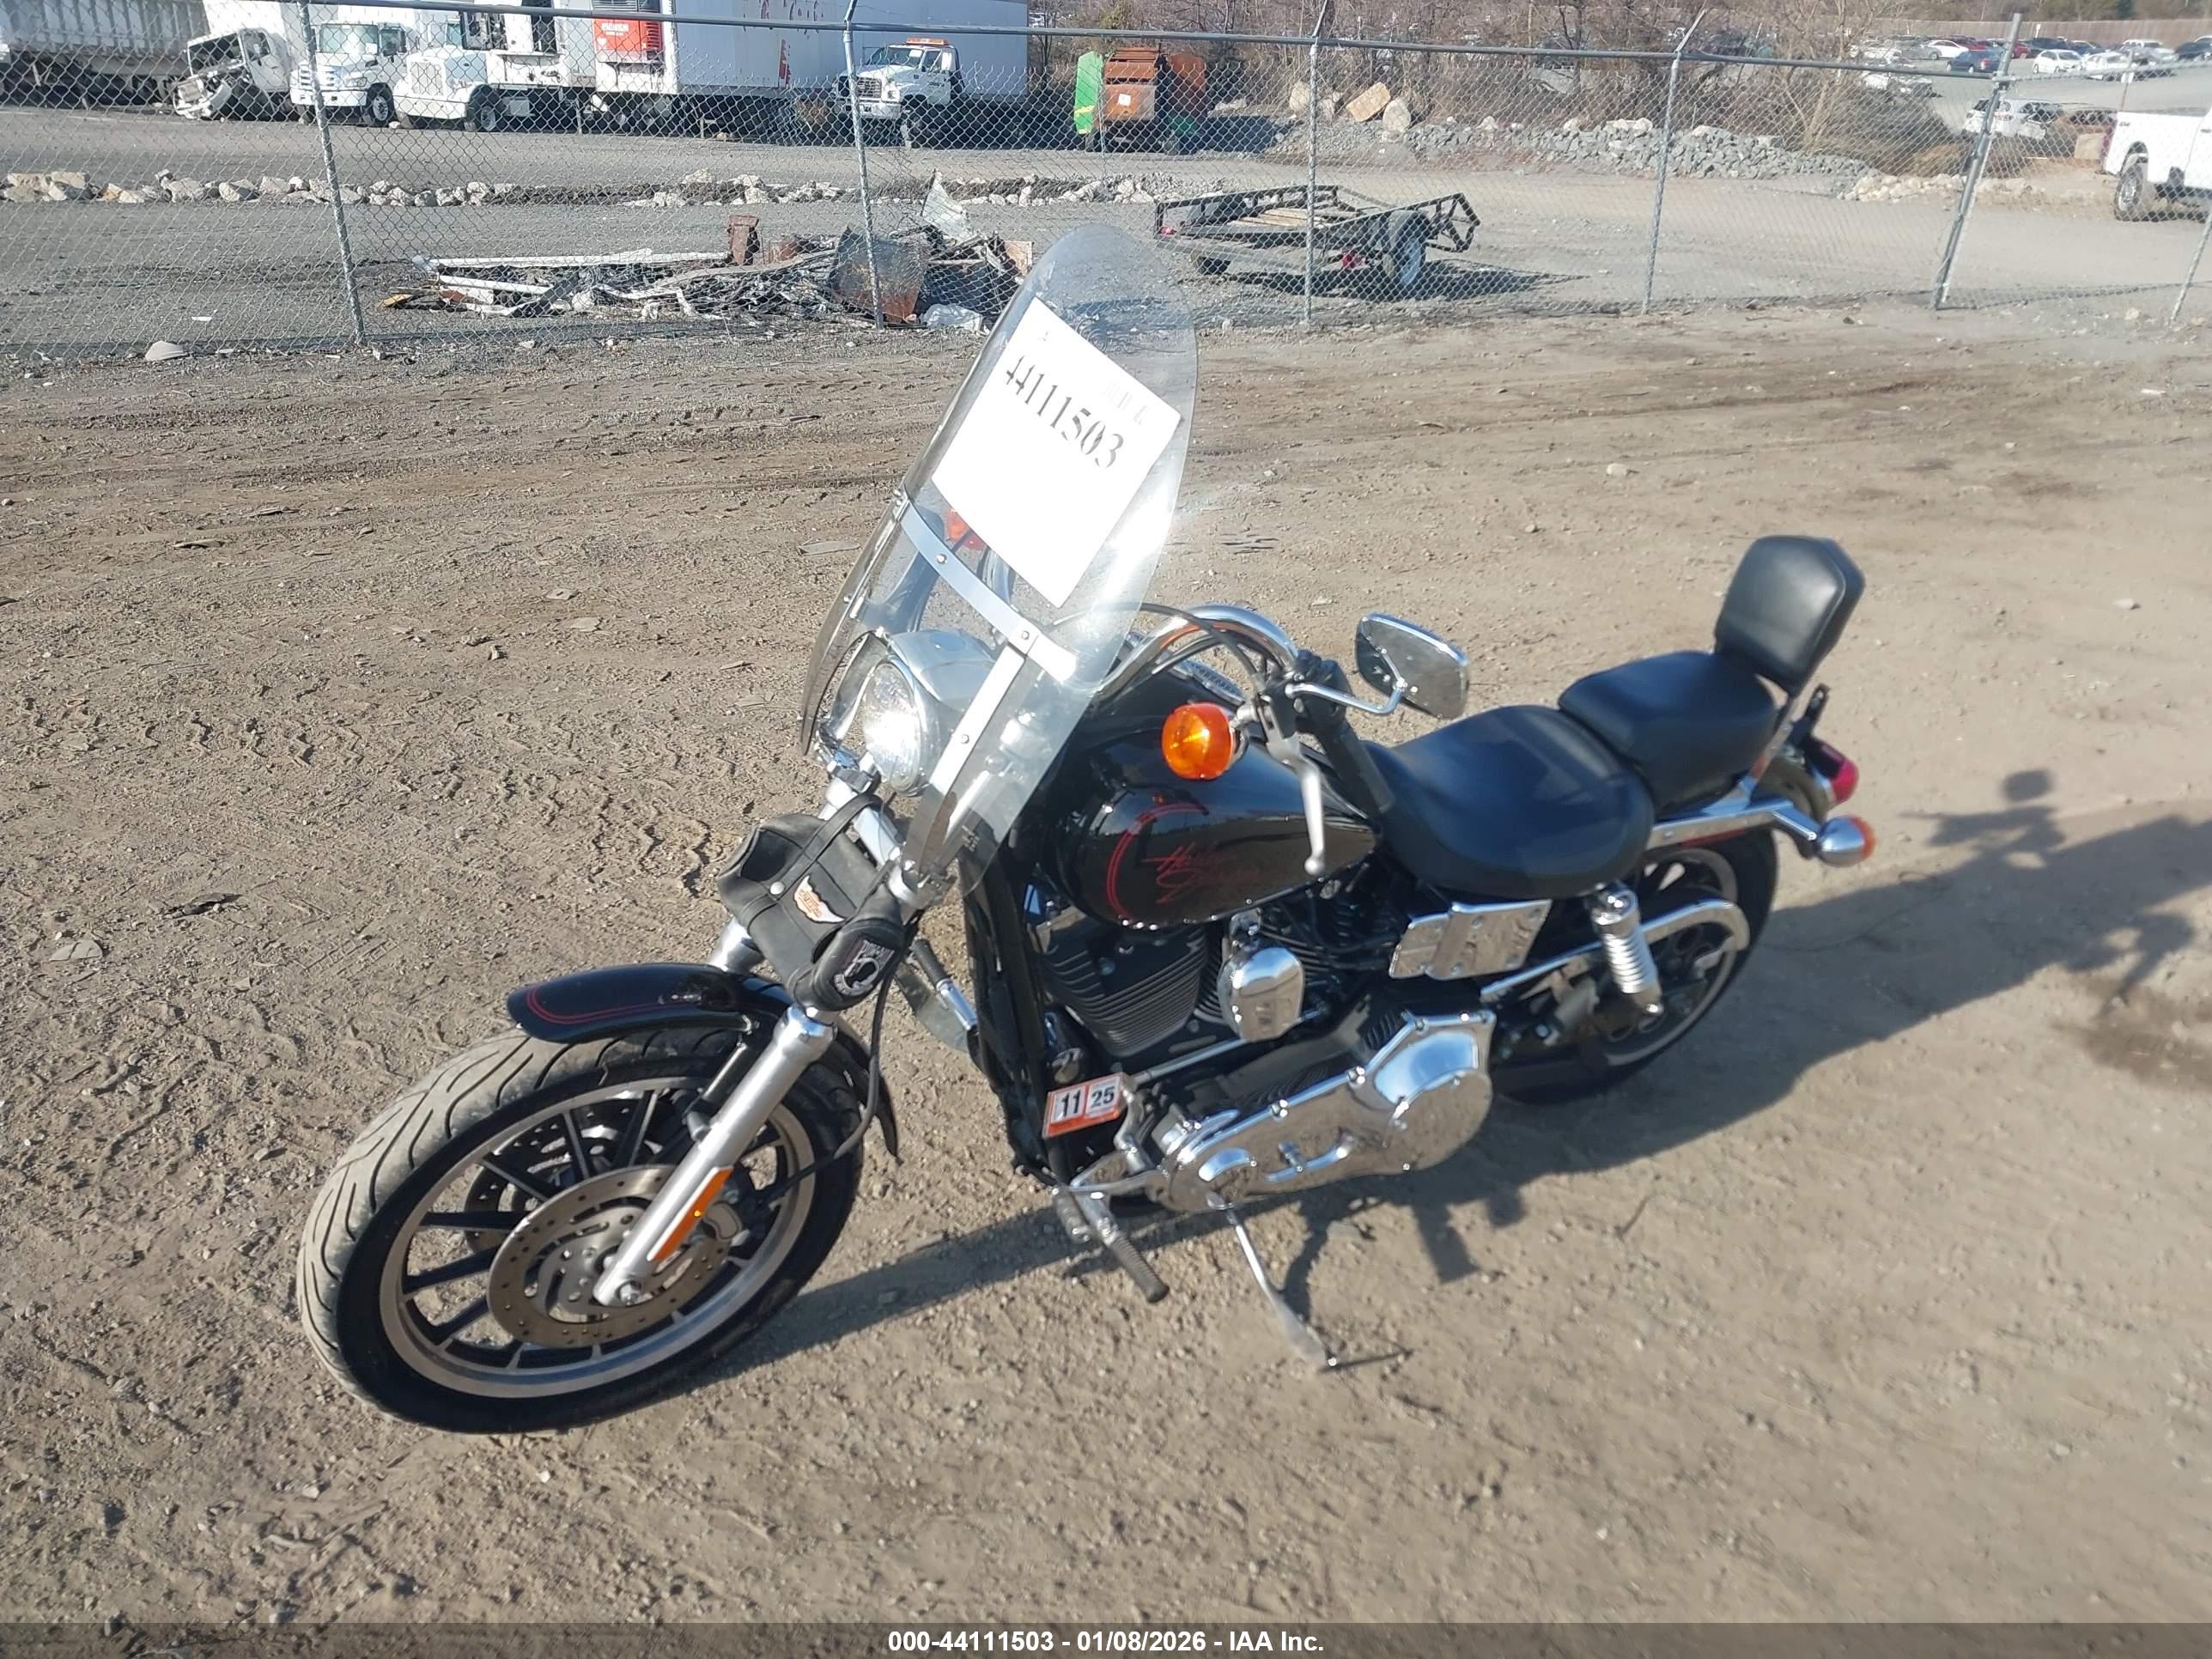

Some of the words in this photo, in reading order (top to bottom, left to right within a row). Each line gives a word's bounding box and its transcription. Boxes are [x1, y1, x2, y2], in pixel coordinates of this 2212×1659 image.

[1006, 355, 1124, 468] 44111503
[1060, 1089, 1081, 1117] 11
[1091, 1085, 1115, 1109] 25
